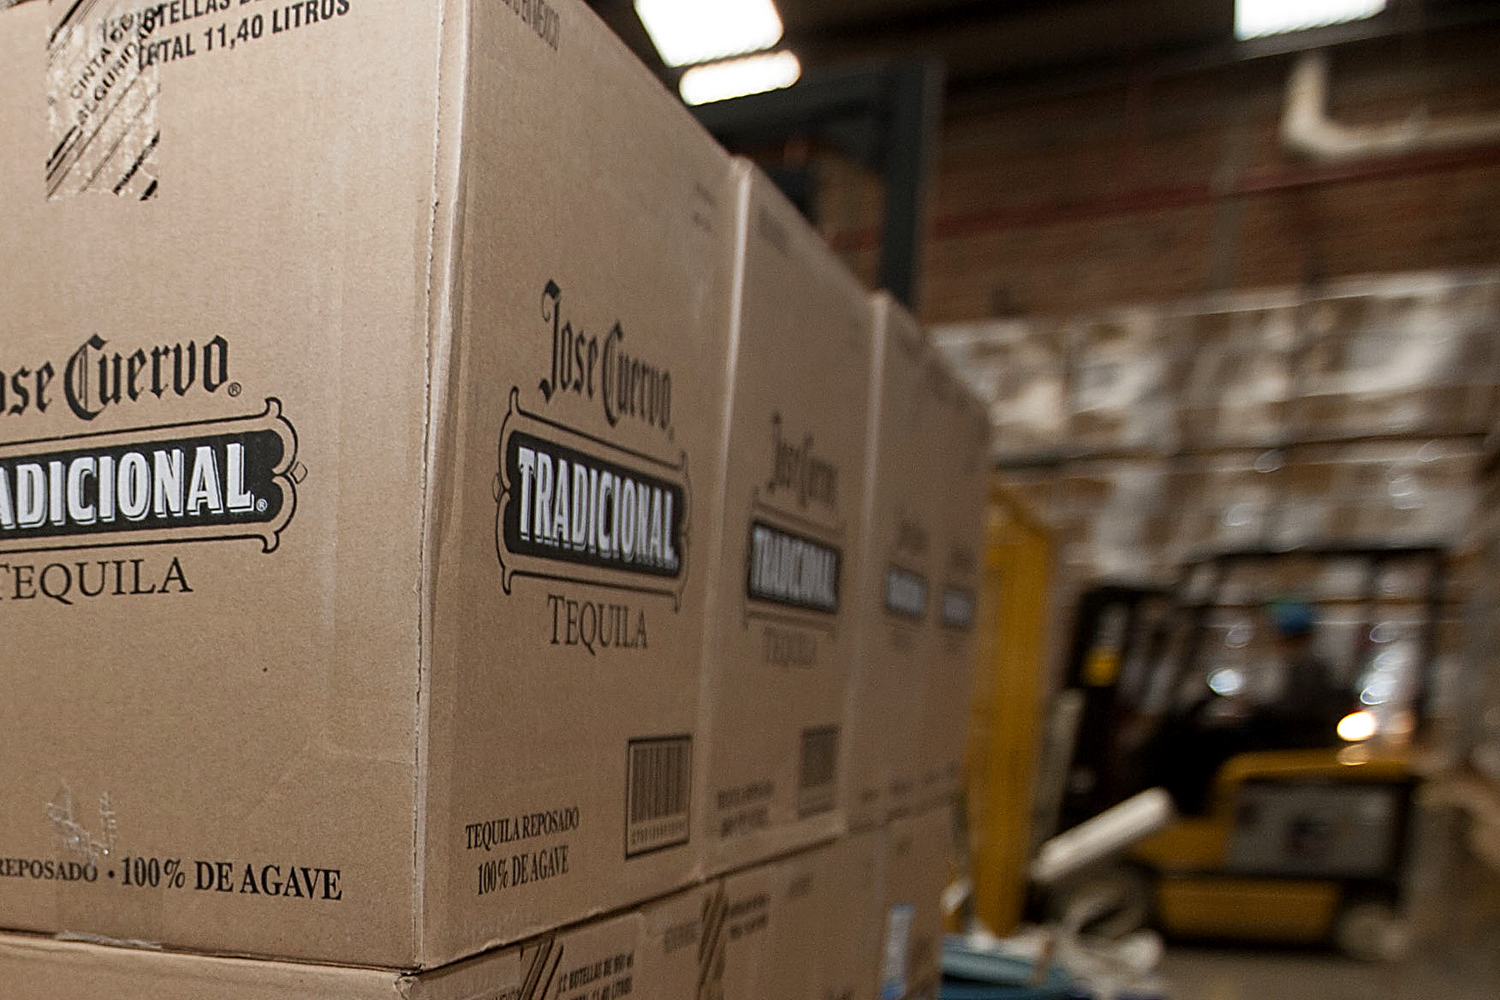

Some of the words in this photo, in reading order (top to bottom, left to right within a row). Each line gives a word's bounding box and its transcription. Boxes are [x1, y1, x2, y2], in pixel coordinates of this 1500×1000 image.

[204, 15, 263, 51] 11,40
[271, 0, 350, 35] LITROS
[70, 46, 112, 99] CINTA
[64, 332, 230, 421] Cuervo
[538, 278, 600, 404] Jose
[602, 318, 672, 434] Cuervo
[517, 446, 679, 571] TRADICIONAL
[547, 593, 649, 656] TEQUILA
[465, 816, 521, 852] TEQUILA
[522, 805, 580, 839] REPOSADO
[120, 856, 187, 889] 100%
[193, 860, 235, 893] DE
[238, 862, 343, 901] AGAVE
[477, 857, 509, 896] 100%
[511, 853, 529, 888] DE
[530, 844, 570, 883] AGAVE
